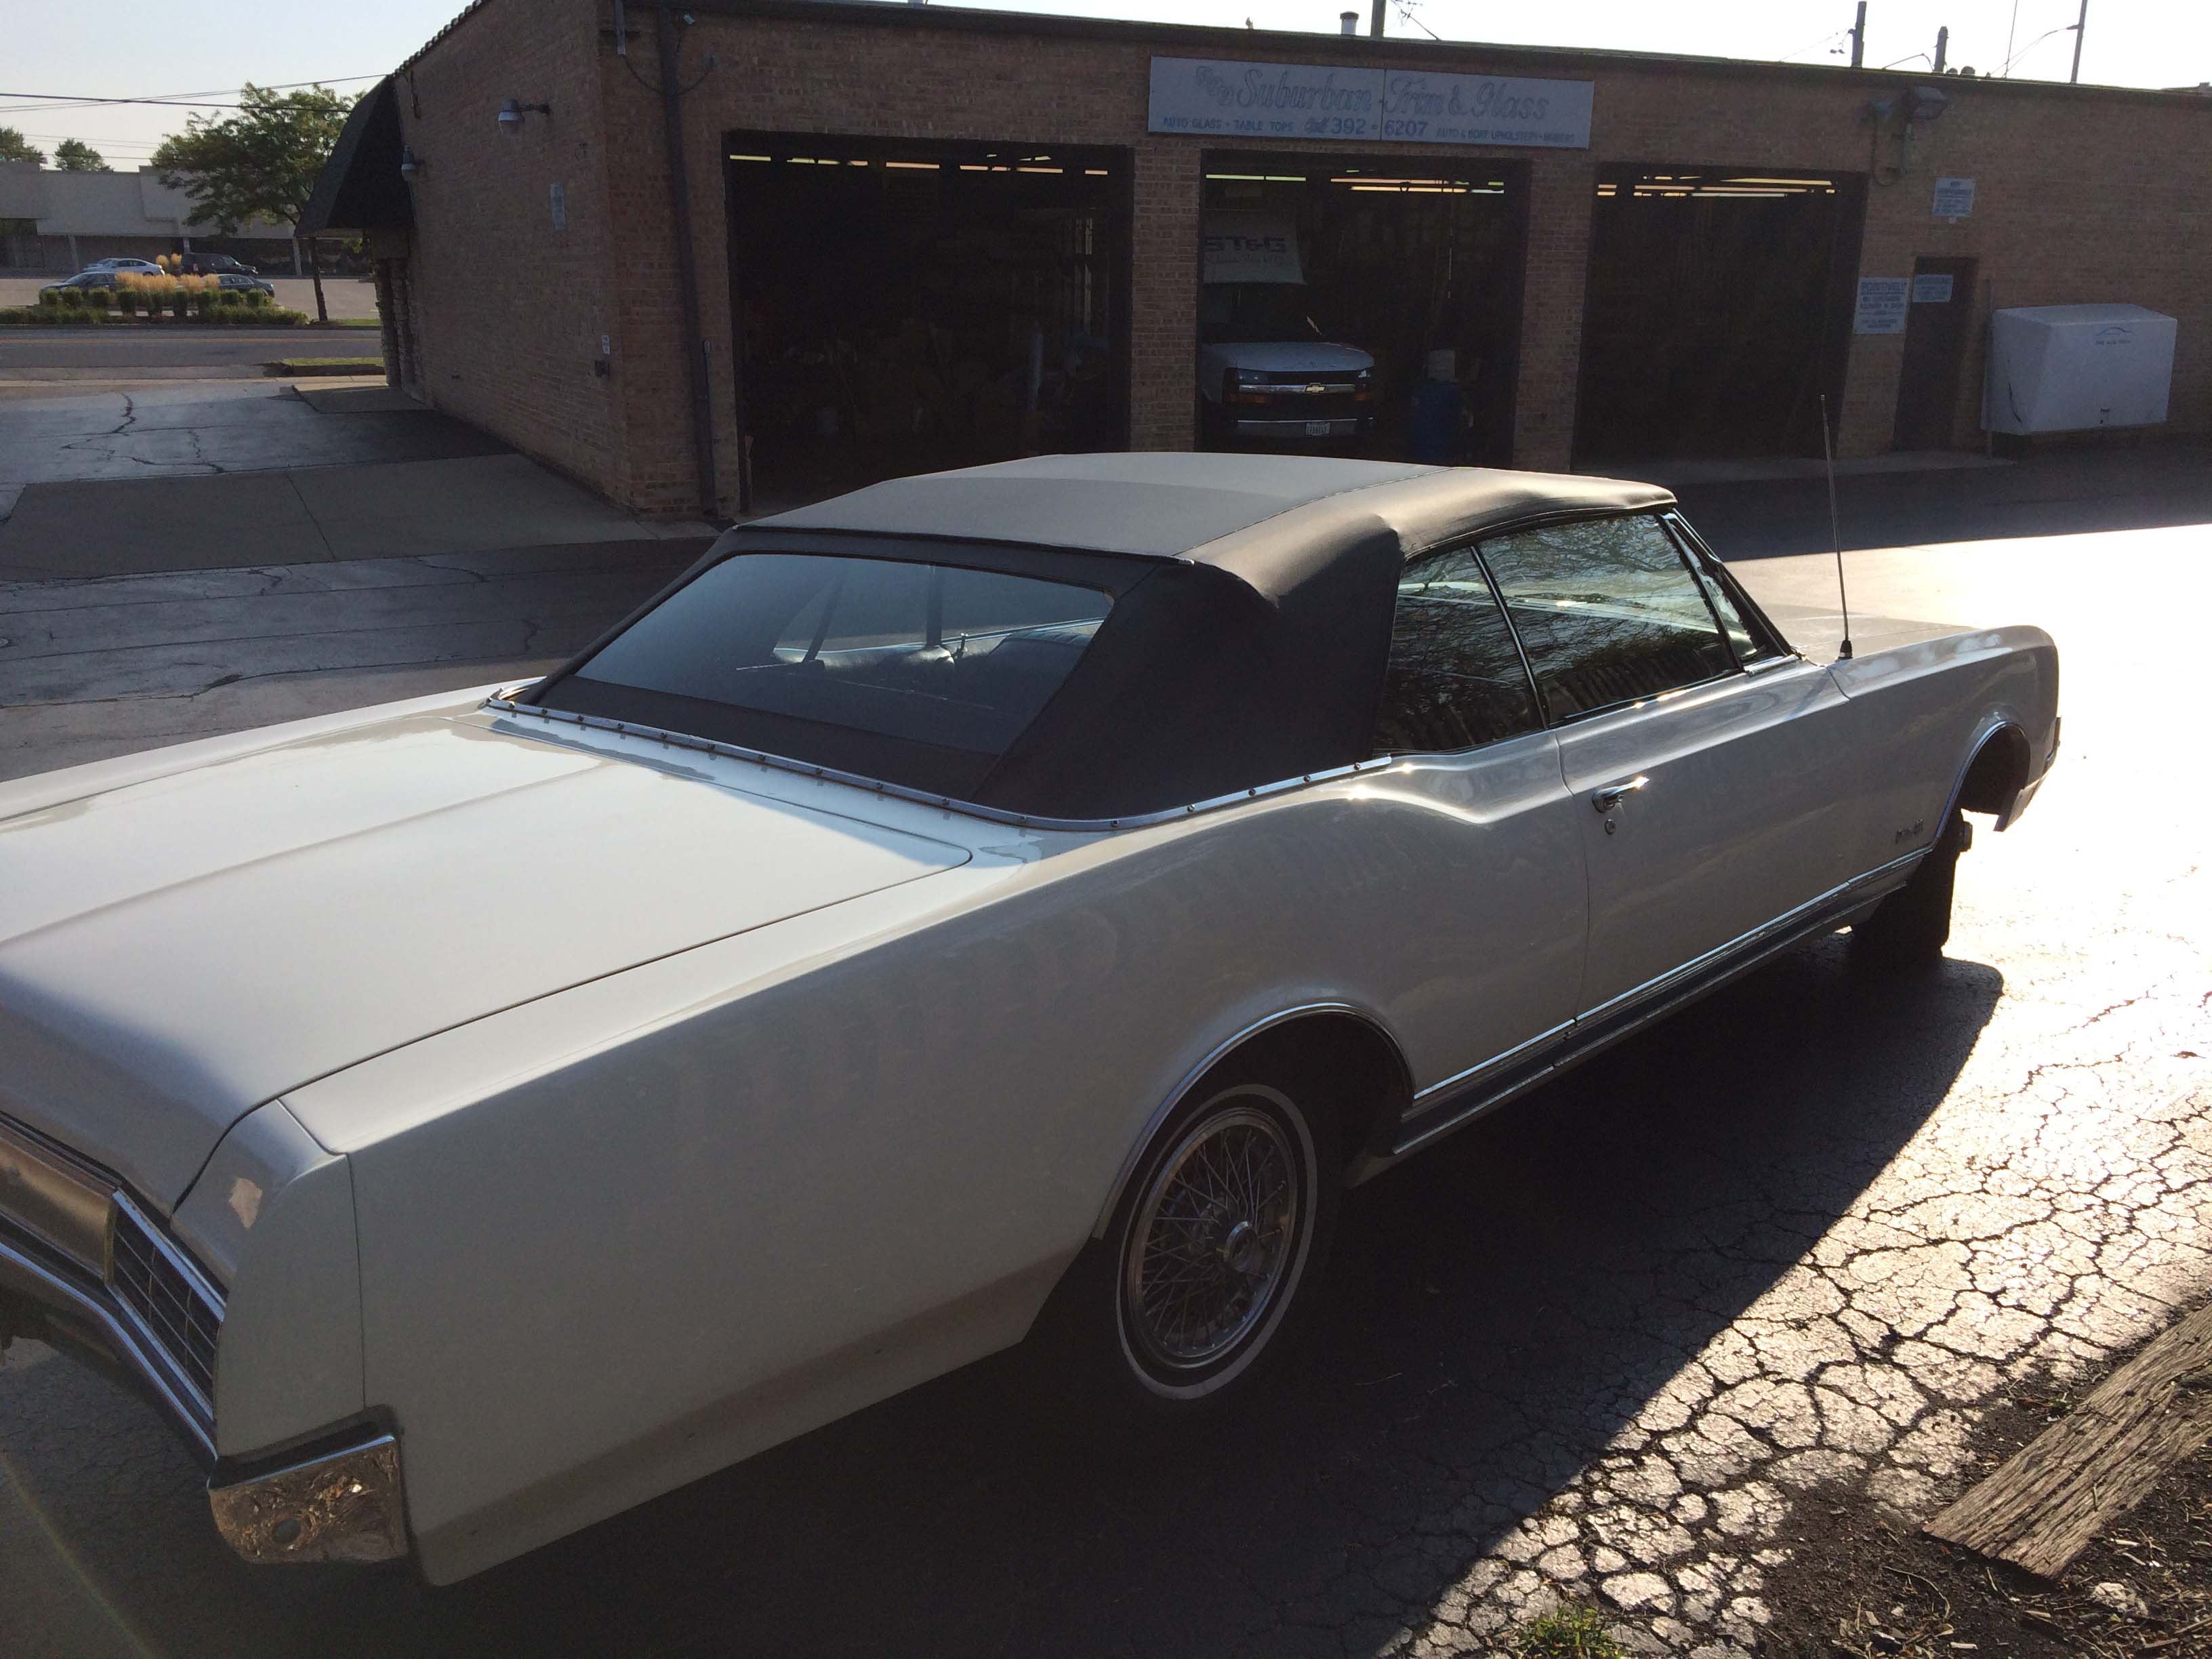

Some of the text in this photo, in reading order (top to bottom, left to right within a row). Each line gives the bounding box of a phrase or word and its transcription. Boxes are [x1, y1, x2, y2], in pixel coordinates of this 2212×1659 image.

[1236, 69, 1373, 110] Suburban
[1385, 77, 1443, 115] Trim
[1448, 84, 1466, 116] &
[1471, 81, 1551, 120] Glass
[1162, 117, 1294, 132] AUTO GLASS TABLE TOPS
[1330, 118, 1367, 136] 392
[1385, 120, 1428, 136] 6207
[1436, 127, 1459, 138] AUTO
[1469, 129, 1489, 140] BOAT
